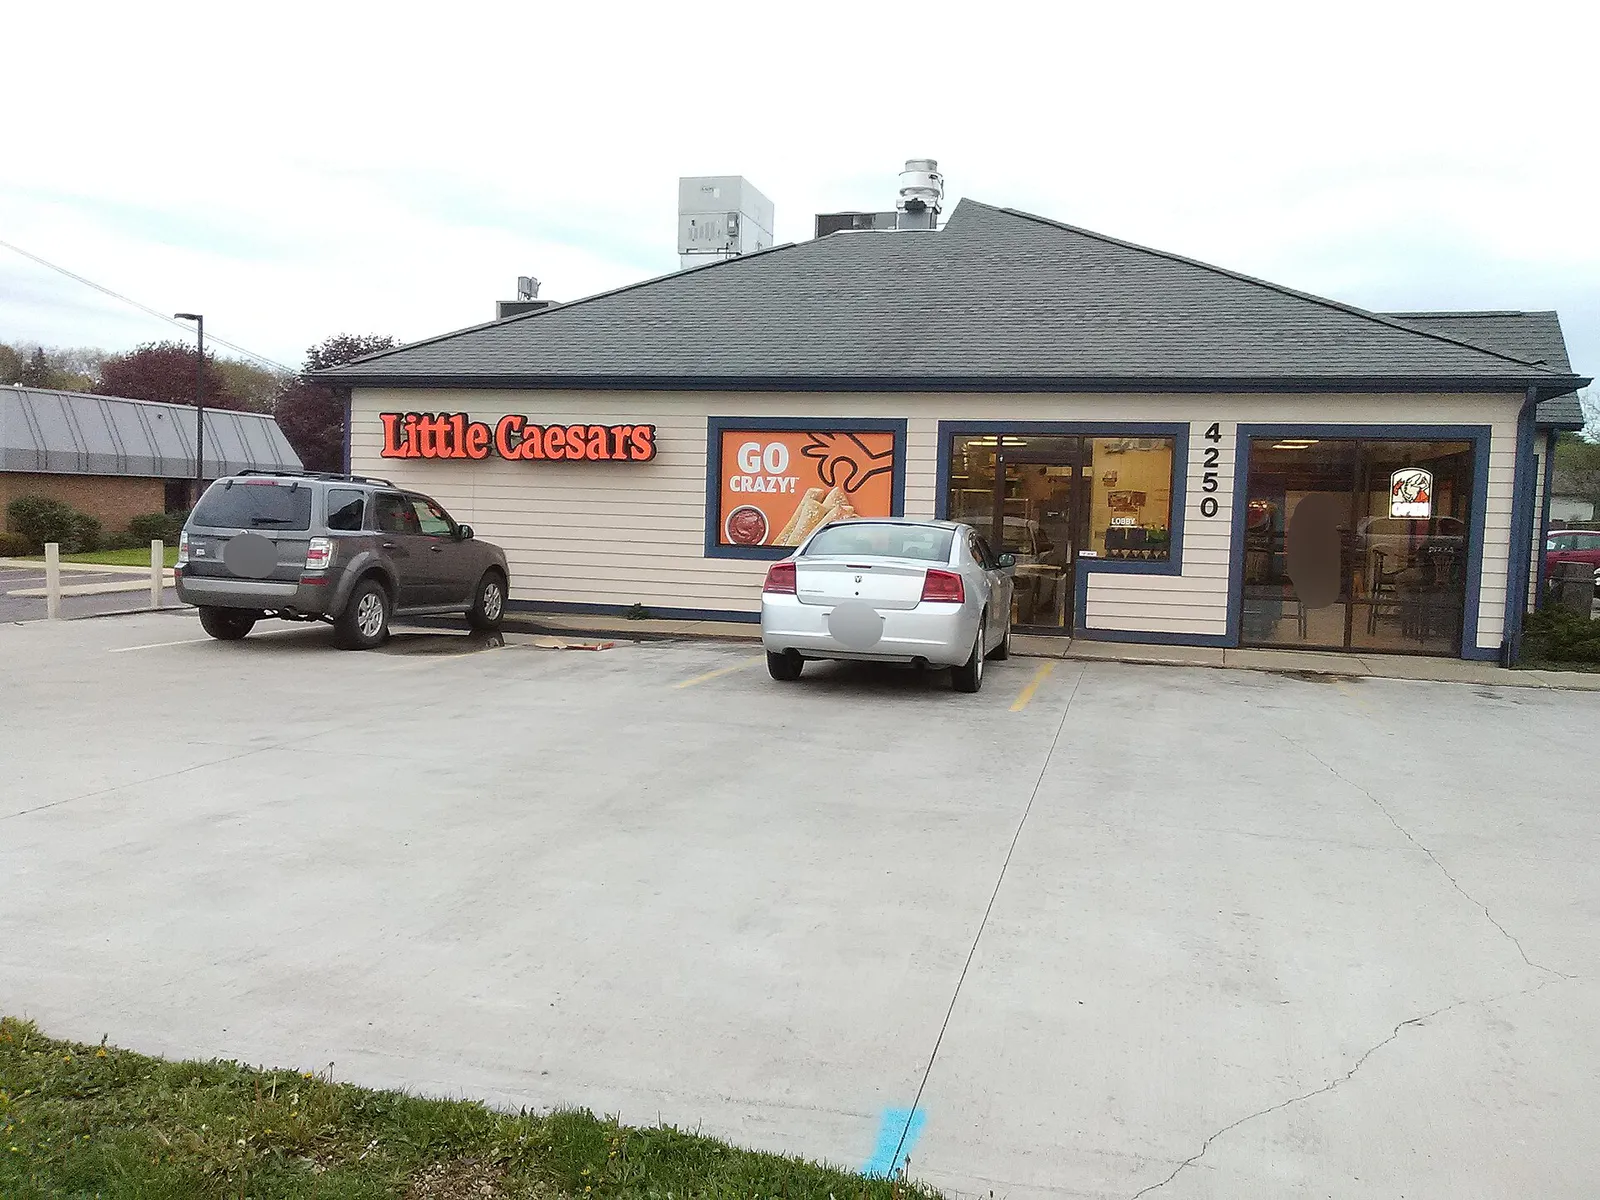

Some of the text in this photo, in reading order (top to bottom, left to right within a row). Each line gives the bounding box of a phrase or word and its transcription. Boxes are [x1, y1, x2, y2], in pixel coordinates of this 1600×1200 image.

[379, 412, 657, 461] Little Caesars
[737, 442, 789, 475] GO
[1199, 422, 1222, 518] 4250
[729, 475, 796, 494] CRAZY!
[1111, 517, 1136, 525] LOBBY
